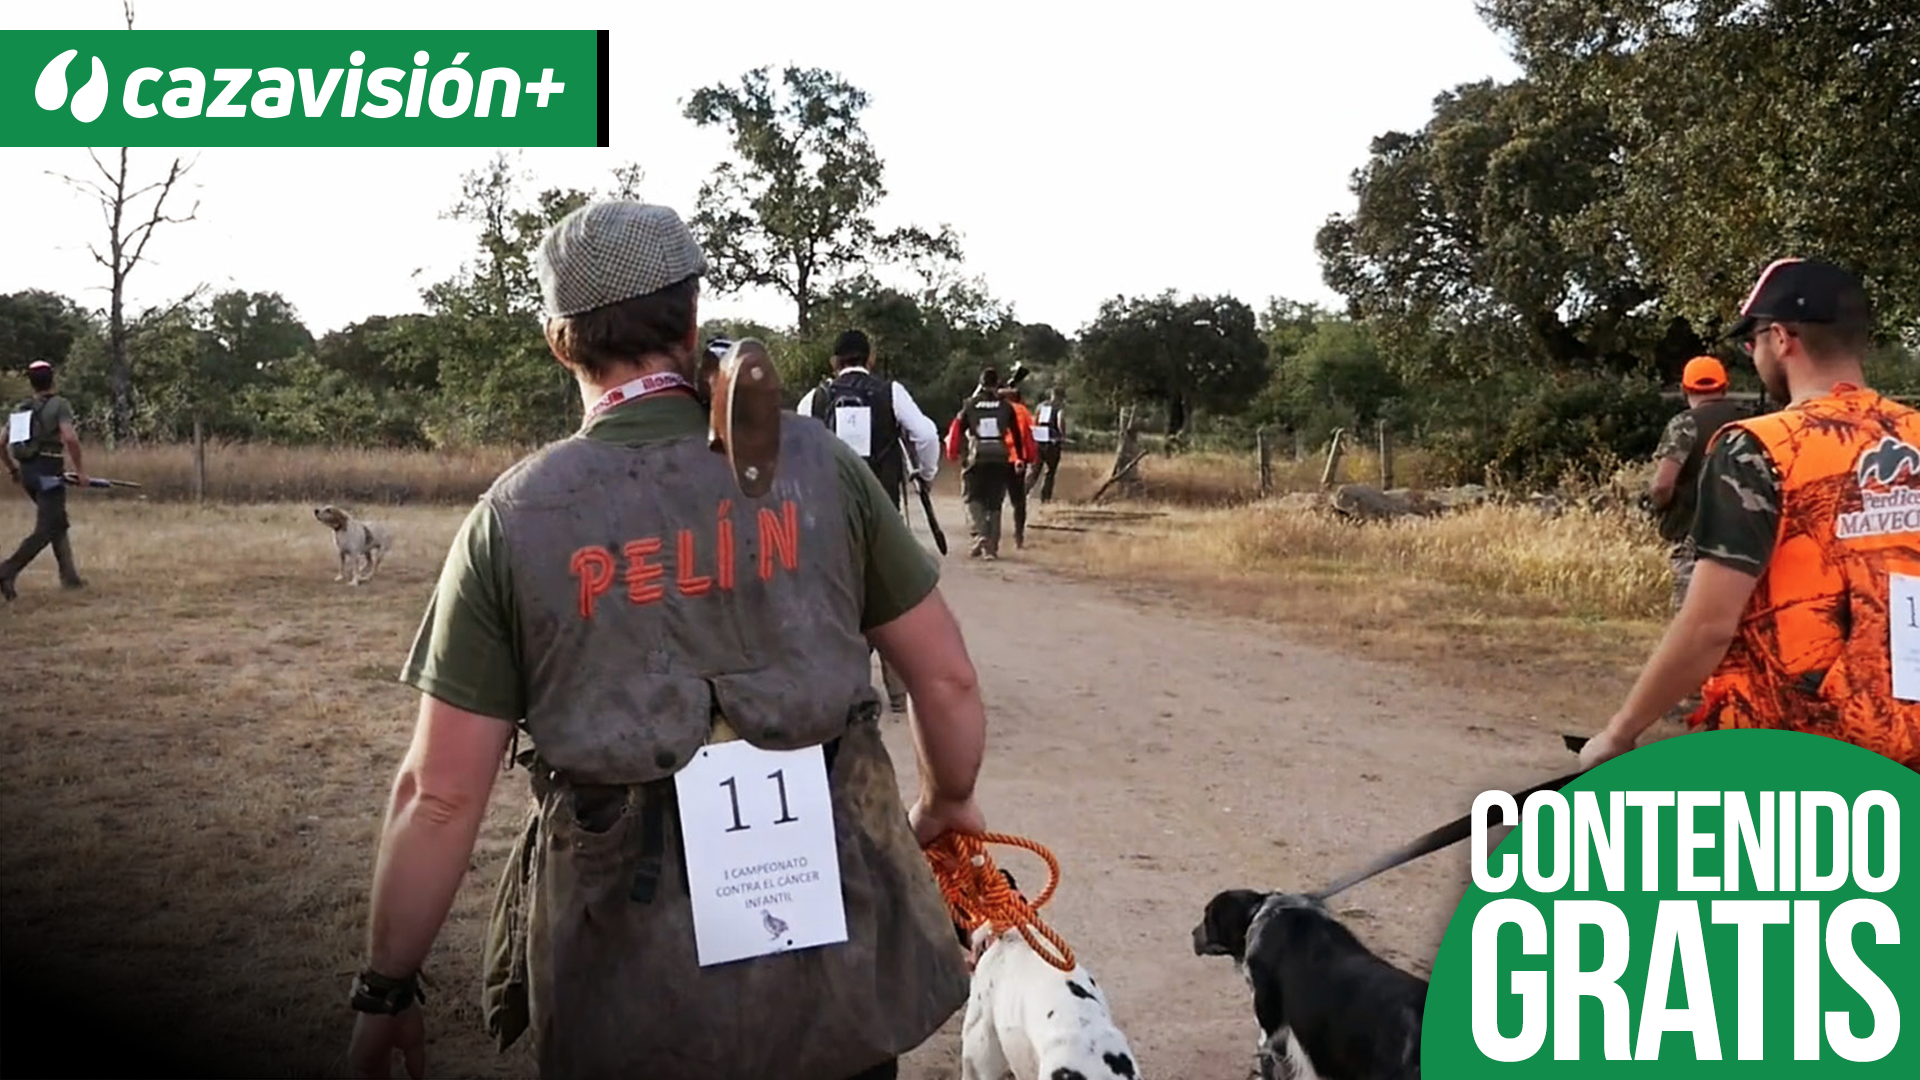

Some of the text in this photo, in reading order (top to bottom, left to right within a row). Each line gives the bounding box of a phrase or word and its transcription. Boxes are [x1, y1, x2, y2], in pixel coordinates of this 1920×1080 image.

[1838, 509, 1920, 536] MAVEC
[569, 499, 798, 619] PELÍN
[719, 769, 799, 833] 11
[731, 857, 808, 879] CAMPEONATO
[716, 881, 761, 898] CONTRA
[763, 880, 774, 889] EL
[745, 892, 793, 909] INFANTIL
